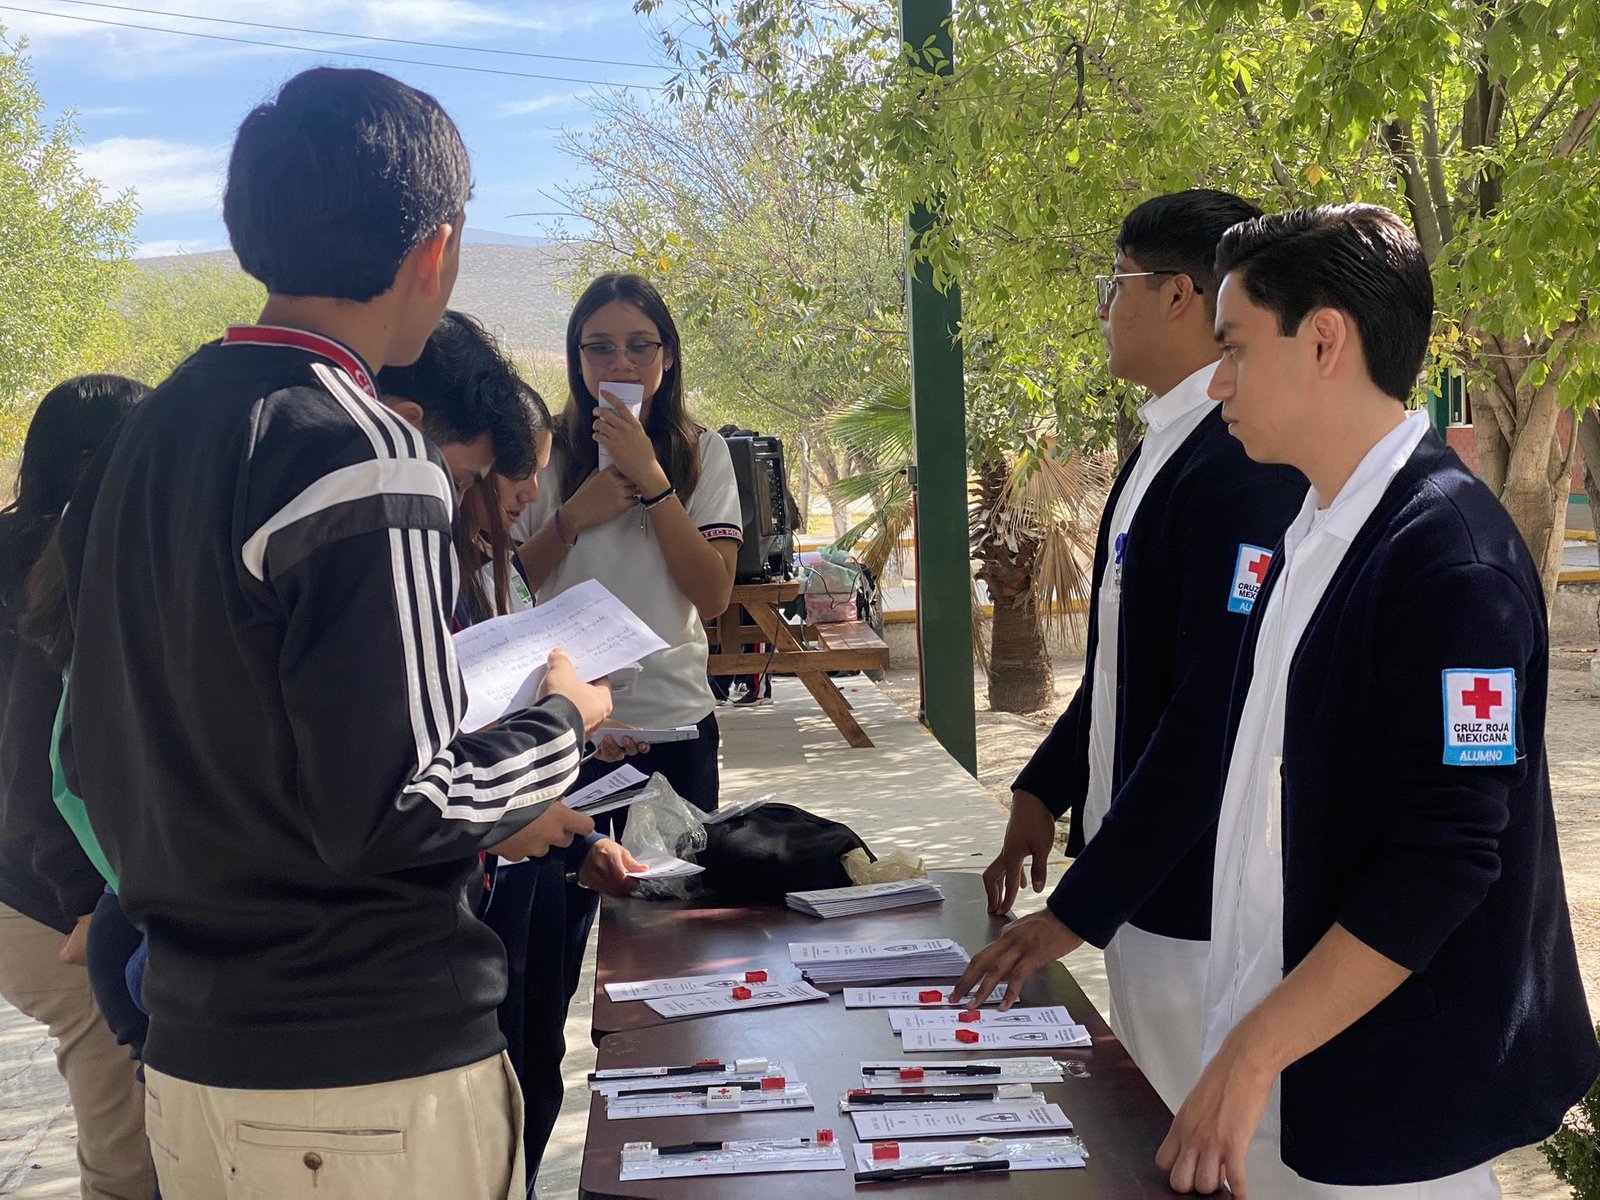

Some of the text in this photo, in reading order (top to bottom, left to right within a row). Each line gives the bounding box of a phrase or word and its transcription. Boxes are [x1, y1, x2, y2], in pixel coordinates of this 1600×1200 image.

[1238, 583, 1260, 593] CRUZ
[1453, 723, 1509, 732] CRUZ ROJA
[1457, 733, 1507, 743] MEXICANA
[1460, 750, 1503, 761] ALUMNO
